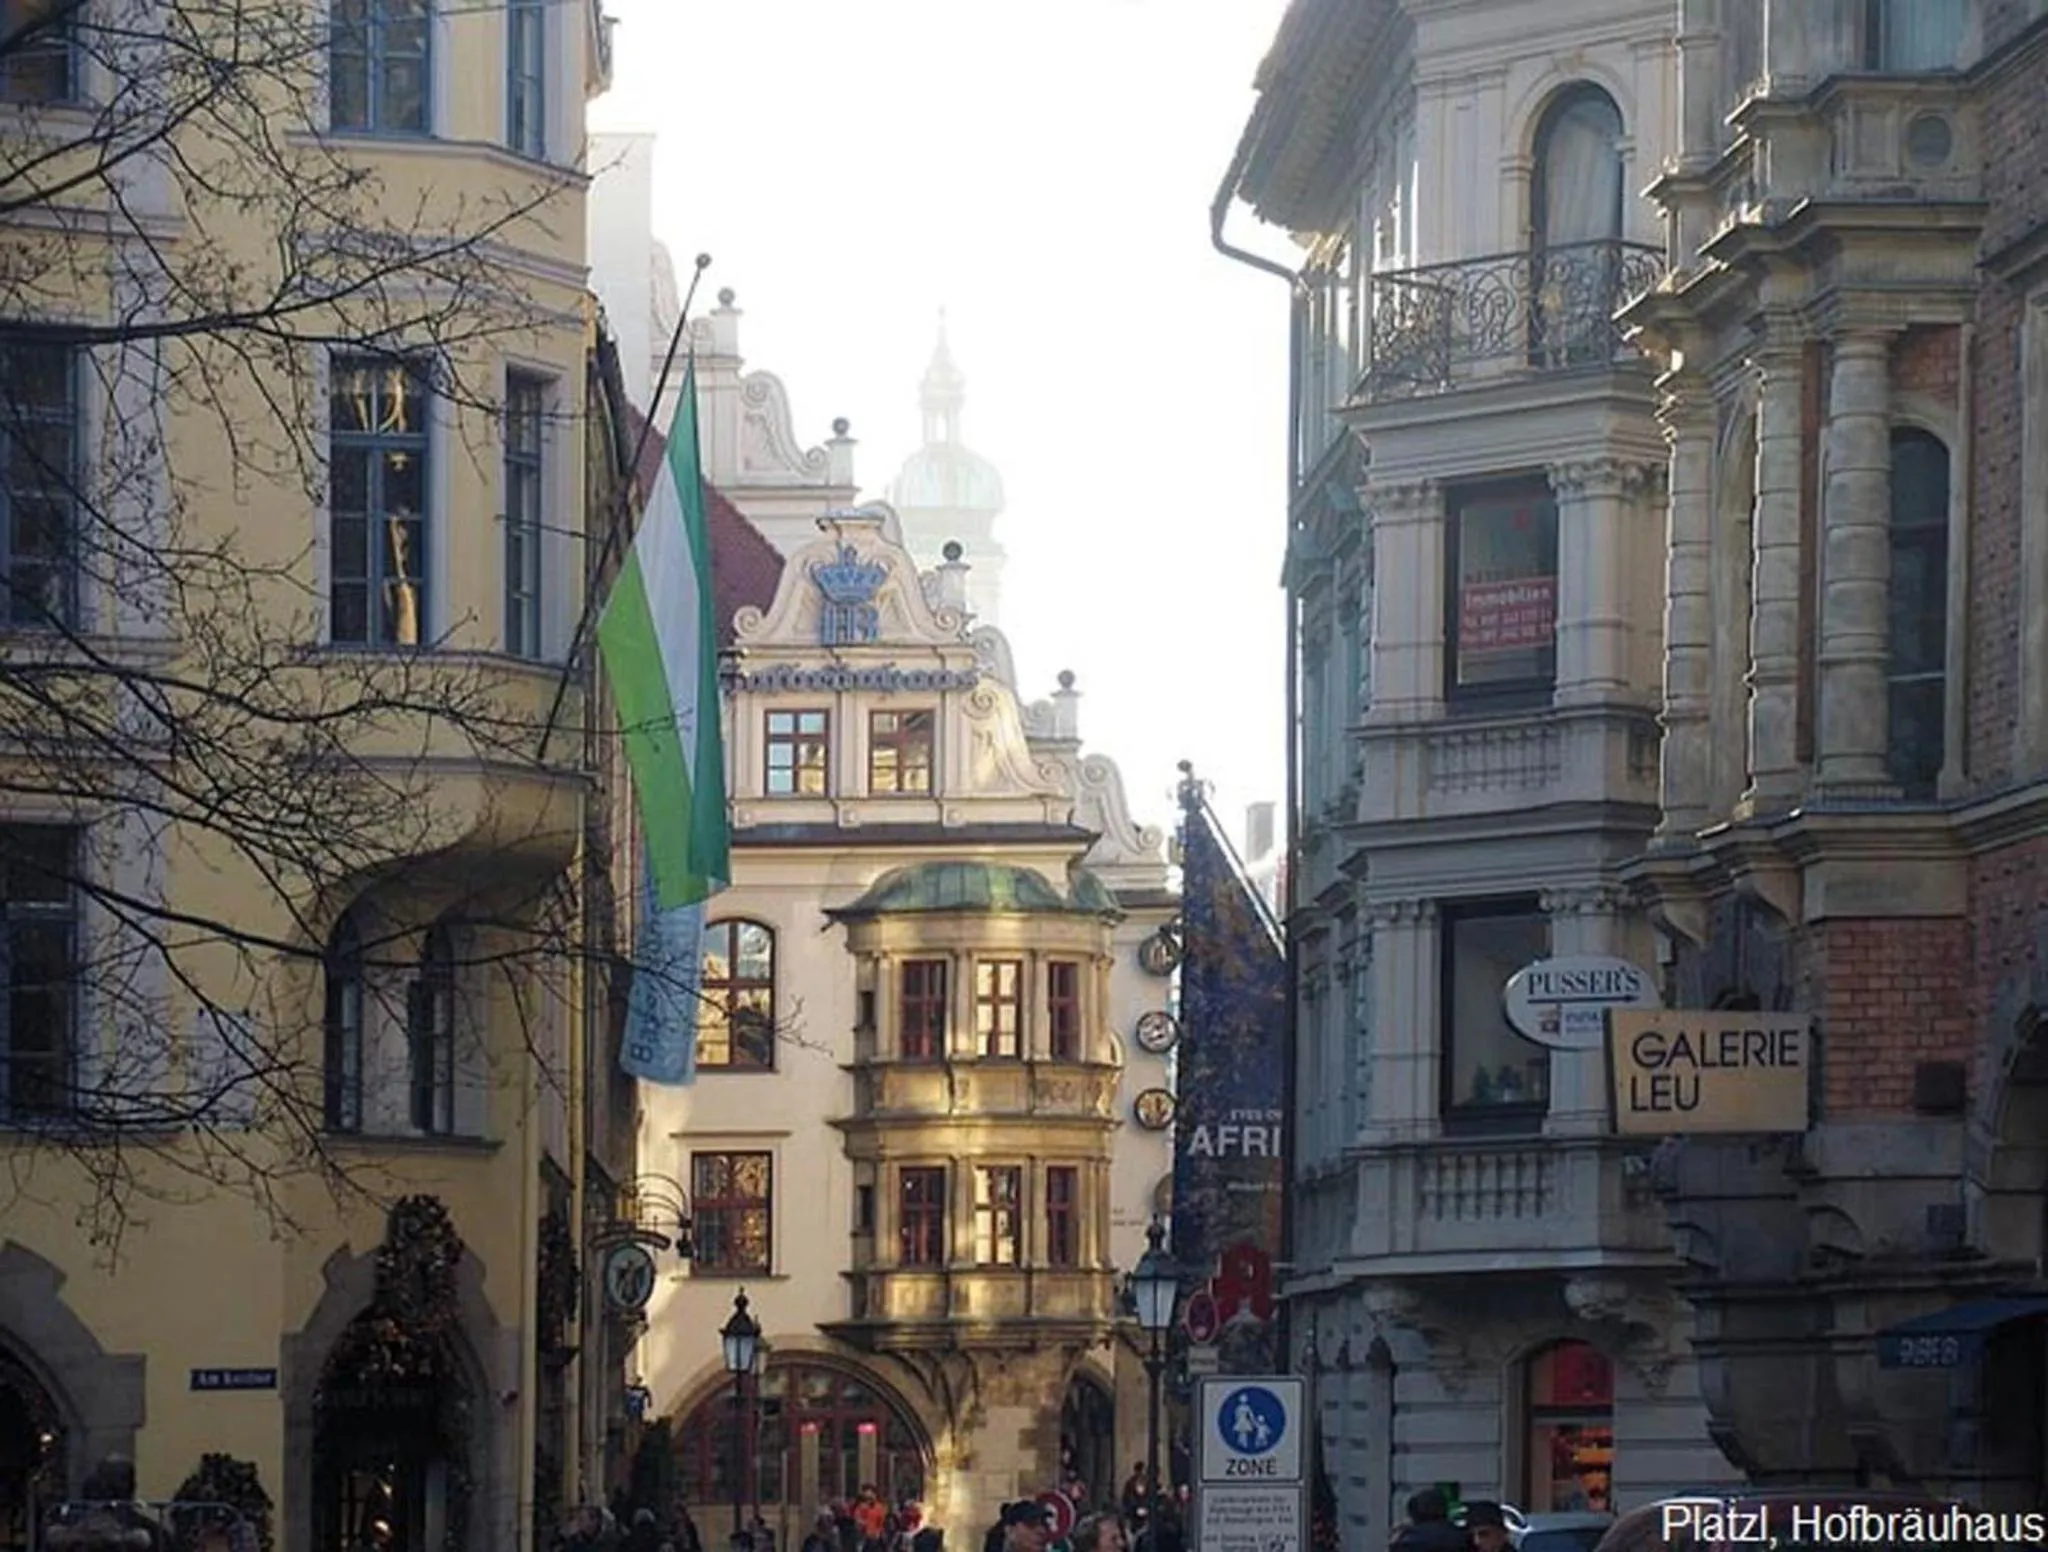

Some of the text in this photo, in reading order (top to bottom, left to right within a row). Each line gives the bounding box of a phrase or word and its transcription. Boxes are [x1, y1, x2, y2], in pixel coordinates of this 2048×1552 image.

[1527, 966, 1641, 995] PUSSER'S
[1631, 1029, 1801, 1068] GALERIE
[1630, 1075, 1700, 1113] LEU
[1186, 1124, 1281, 1157] AFRI
[1225, 1459, 1278, 1476] ZONE
